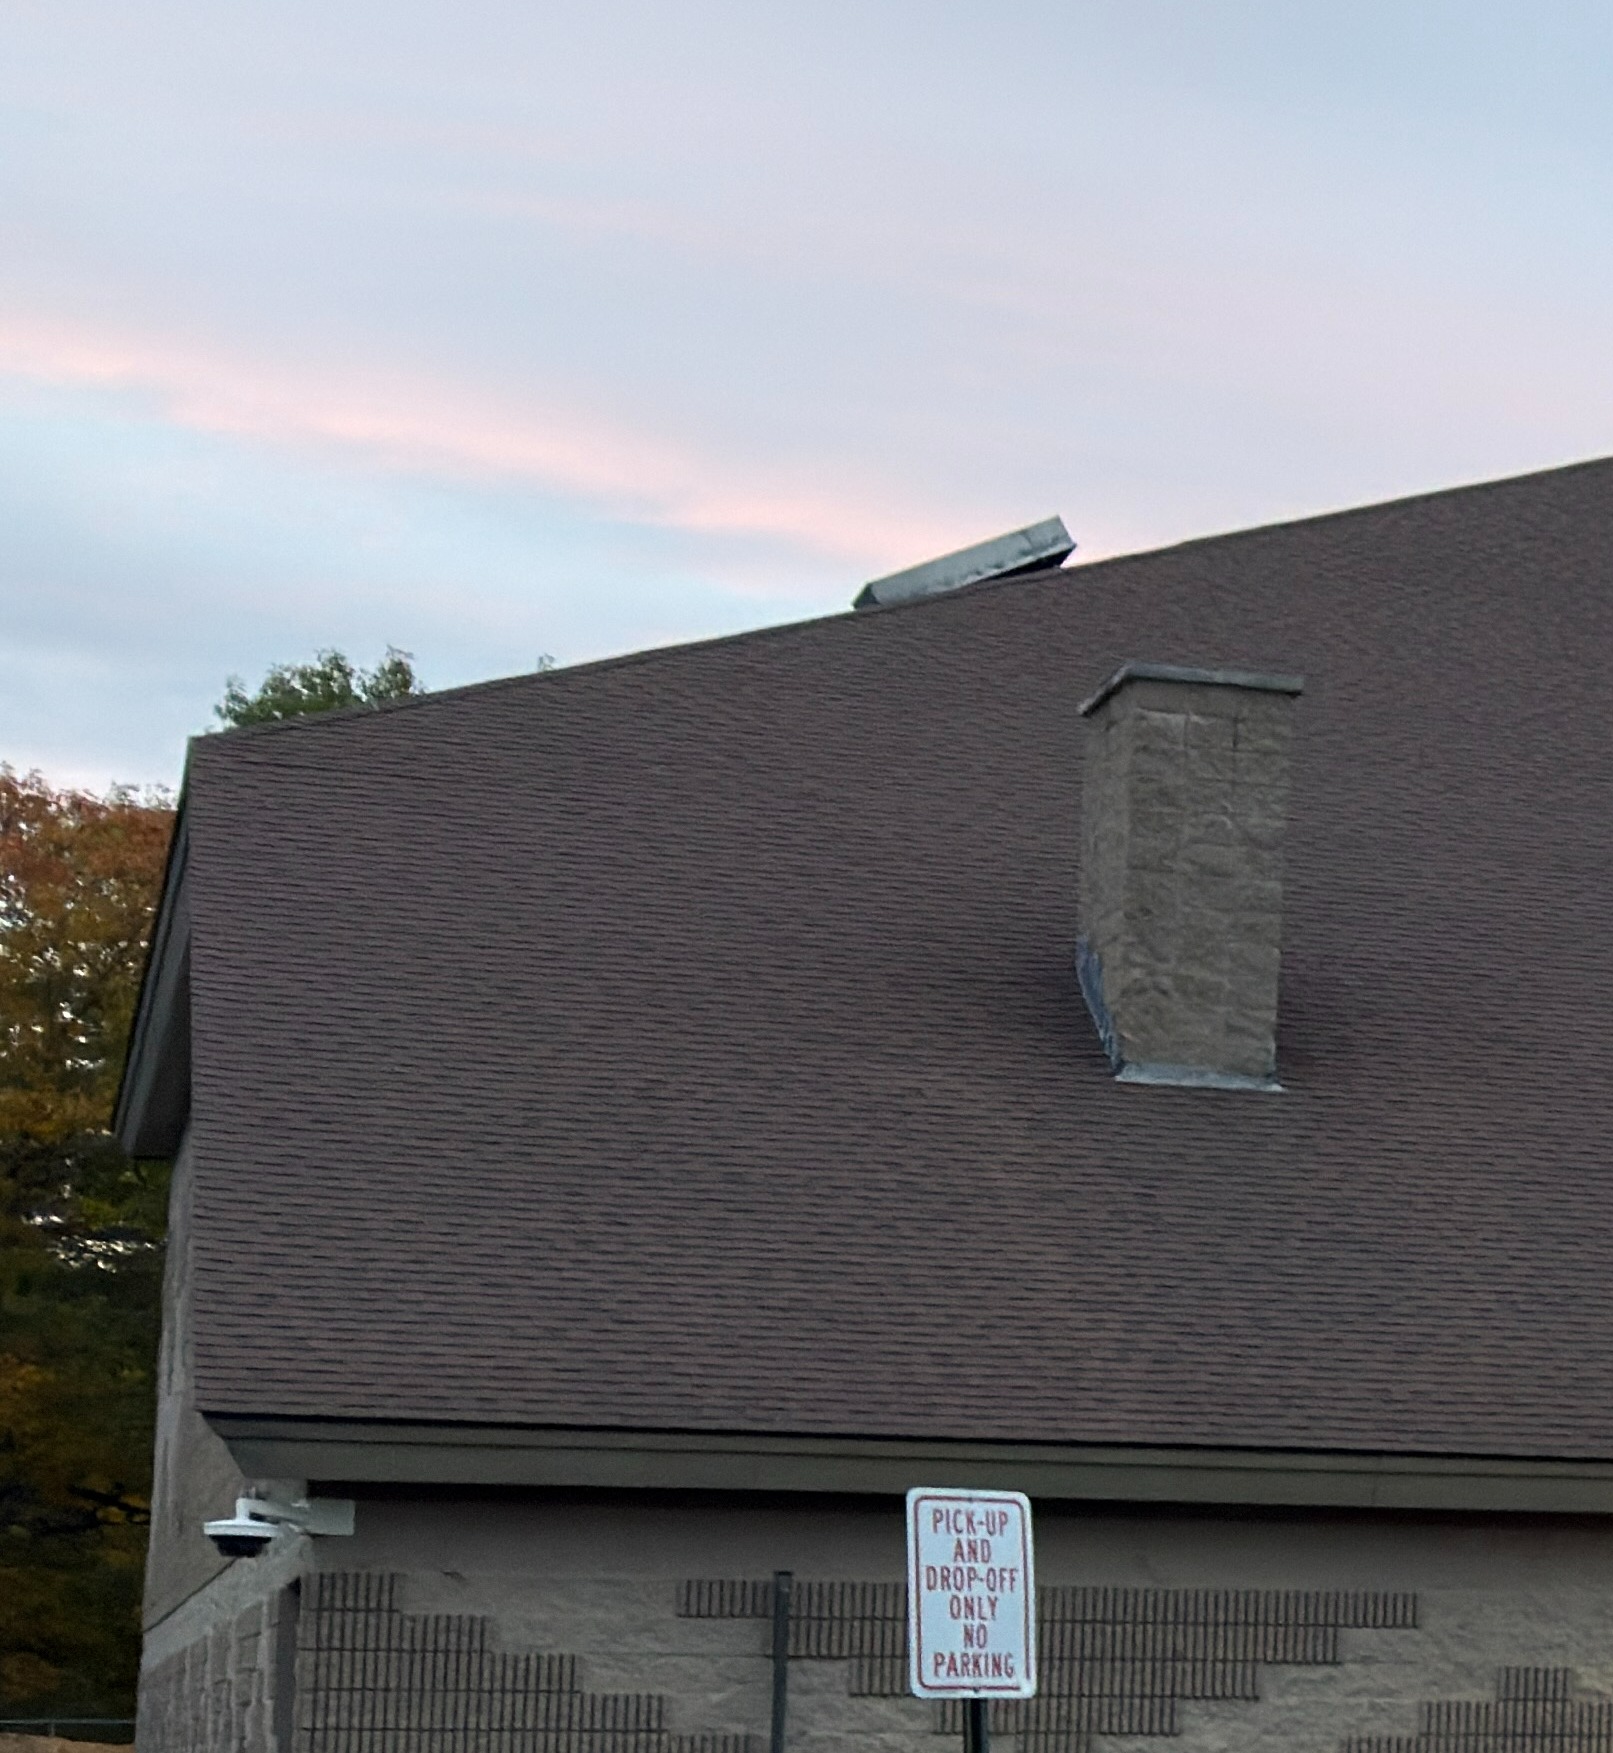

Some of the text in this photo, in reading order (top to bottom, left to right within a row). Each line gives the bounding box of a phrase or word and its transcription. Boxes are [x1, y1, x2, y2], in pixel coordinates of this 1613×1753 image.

[932, 1509, 1008, 1536] PICK-UP
[953, 1539, 991, 1563] AND
[925, 1566, 1018, 1592] DROP-OFF
[950, 1596, 998, 1621] ONLY
[963, 1624, 988, 1649] NO
[933, 1652, 1015, 1678] PARKING
